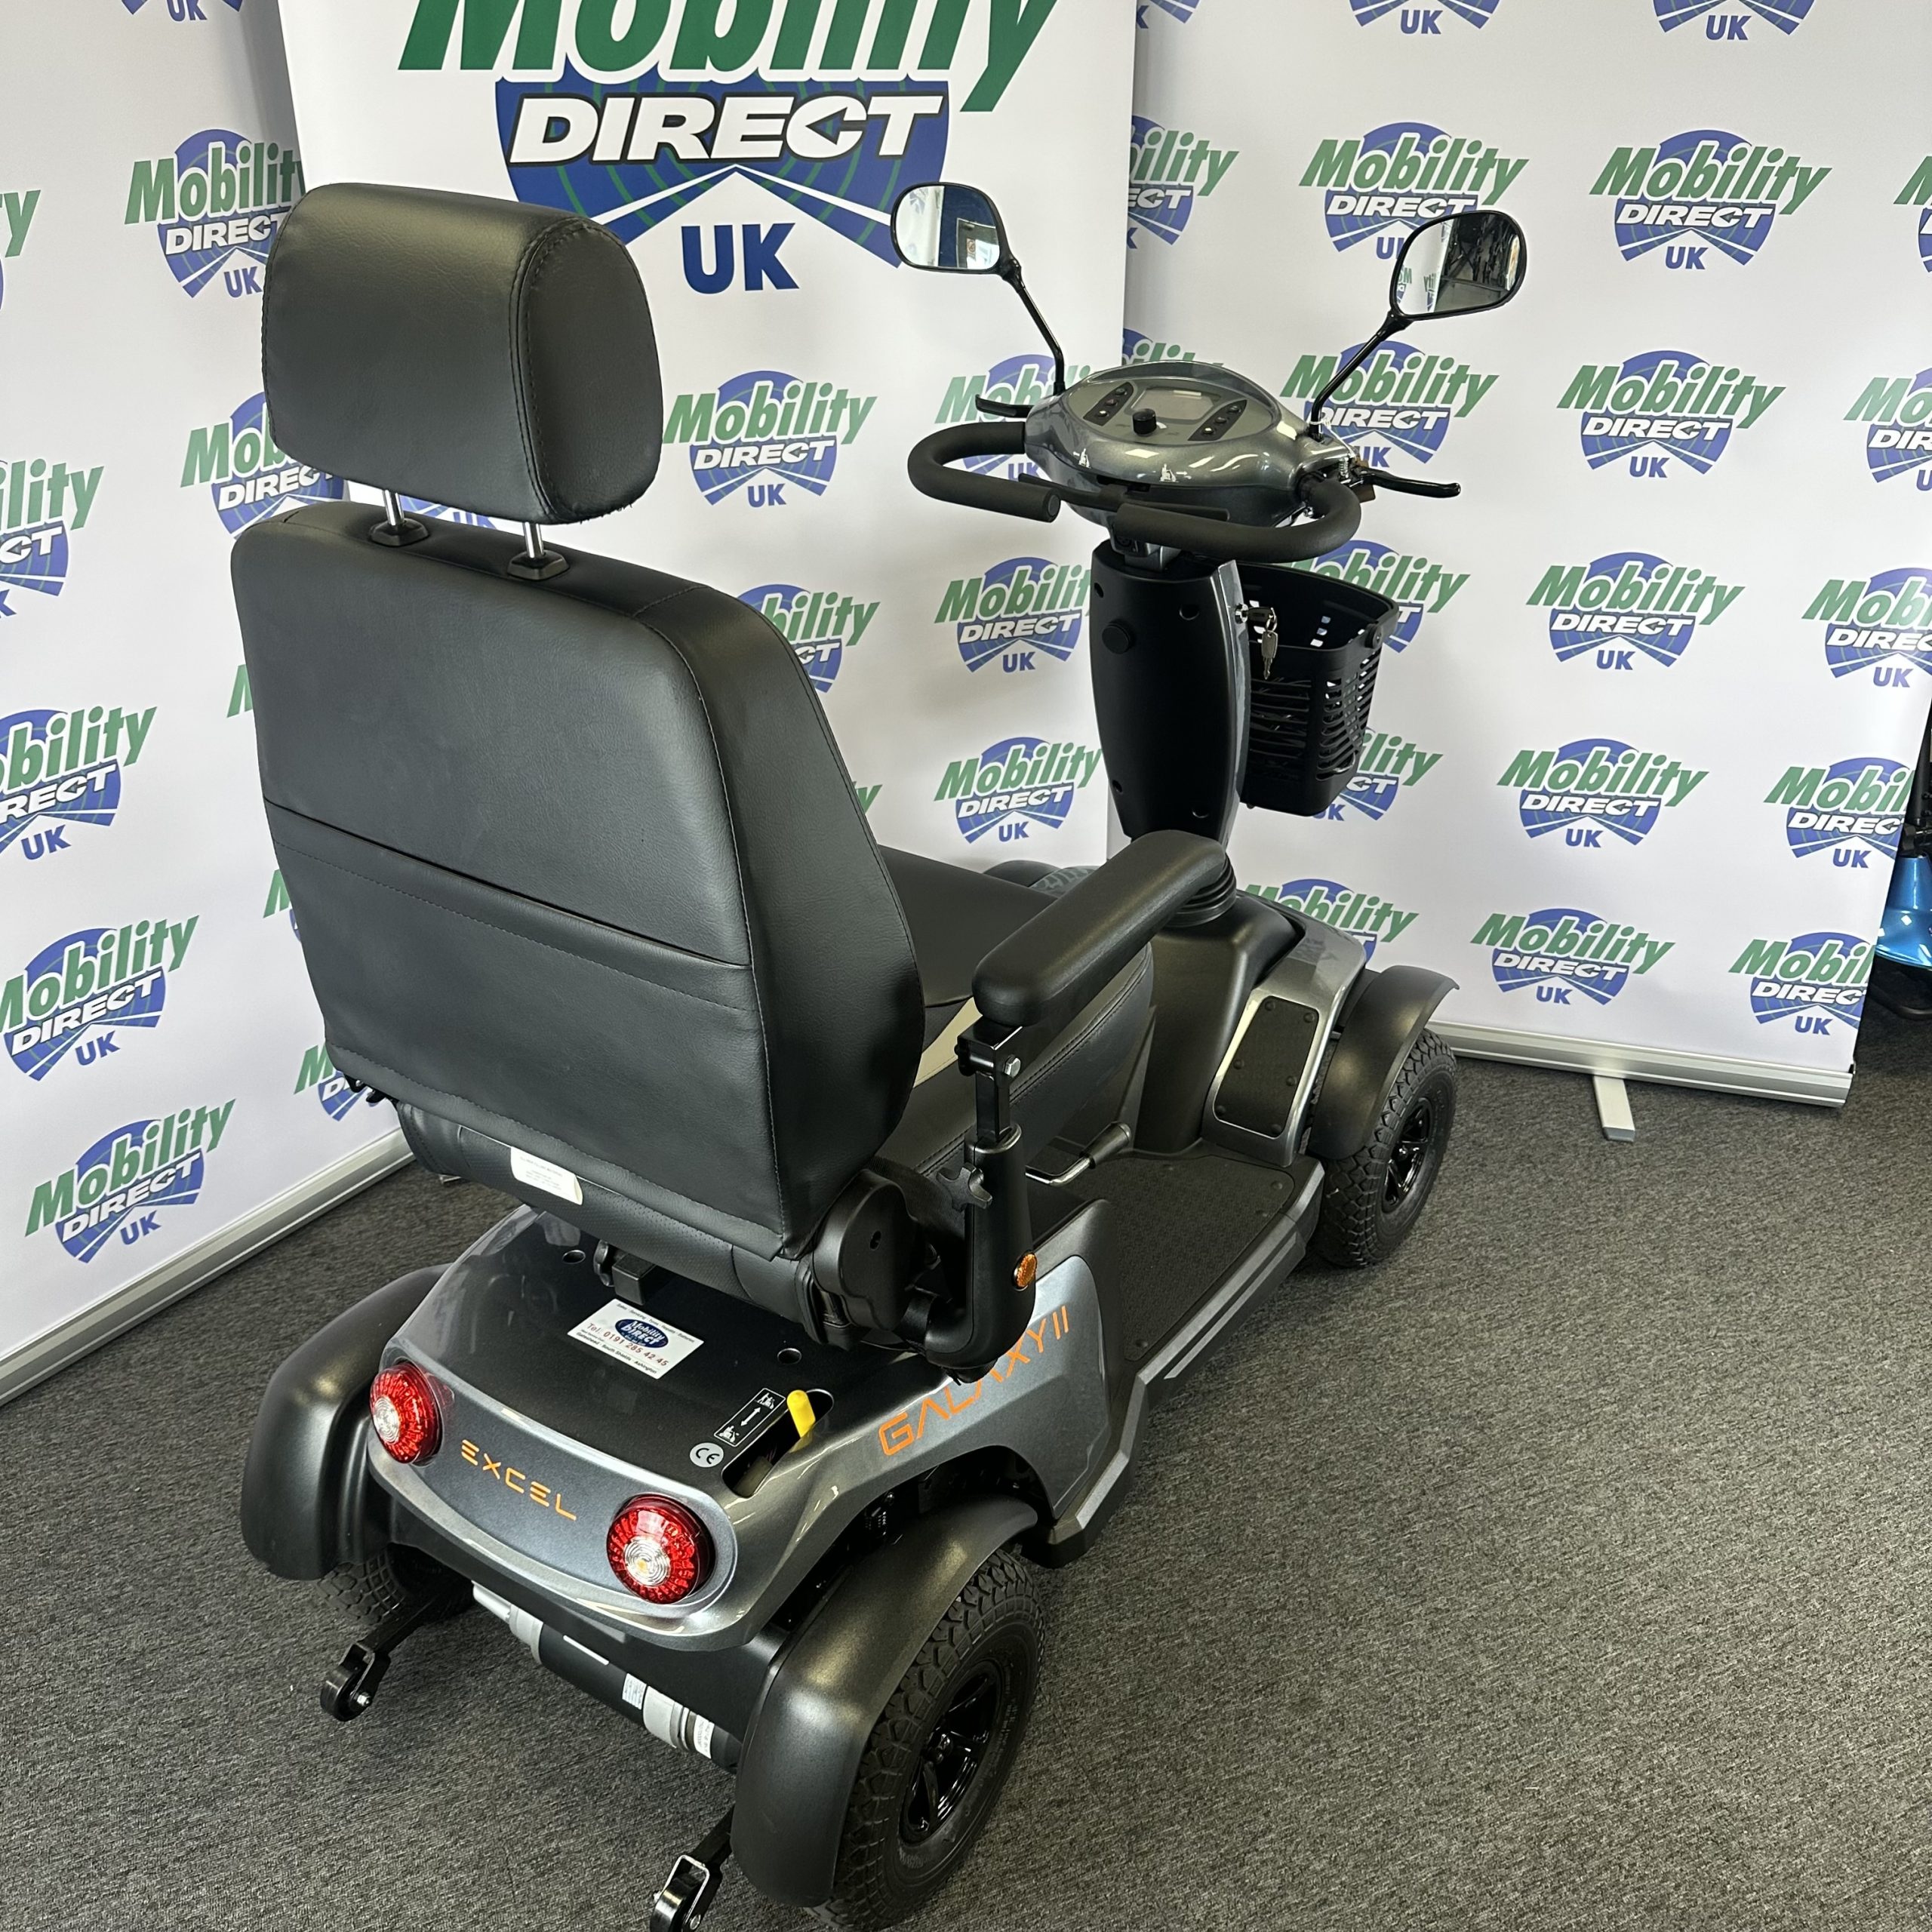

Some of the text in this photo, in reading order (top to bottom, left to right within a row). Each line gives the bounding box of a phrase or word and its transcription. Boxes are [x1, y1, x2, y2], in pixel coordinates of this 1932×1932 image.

[167, 0, 207, 21] UK
[1401, 10, 1443, 35] UK
[1706, 15, 1752, 40] UK
[508, 96, 945, 162] DIRECT
[1131, 130, 1239, 196] ility
[1299, 137, 1530, 205] Mobility
[1589, 145, 1832, 214] Mobility
[1326, 195, 1477, 217] DIRECT
[1617, 203, 1774, 228] DIRECT
[681, 223, 799, 294] UK
[1666, 247, 1707, 269] UK
[223, 266, 262, 298] UK
[1280, 354, 1500, 417] Mobility
[1556, 364, 1786, 429] Mobility
[663, 382, 878, 445] Mobility
[1583, 417, 1730, 441] DIRECT
[1868, 429, 1932, 450] DIR
[694, 441, 834, 470] DIRECT
[1629, 457, 1668, 478] UK
[218, 466, 333, 510] DIREC
[1917, 469, 1932, 491] U
[747, 484, 786, 507] UK
[1526, 565, 1746, 625] Mobility
[761, 592, 881, 647] bility
[959, 614, 1079, 643] DIRECT
[1551, 614, 1693, 635] DIRECT
[1826, 629, 1932, 651] DIREC
[1002, 652, 1035, 672] UK
[1596, 651, 1633, 669] UK
[1873, 667, 1914, 688] UK
[0, 706, 157, 790] bility
[934, 743, 1102, 801] Mobility
[1497, 750, 1709, 807] Mobility
[0, 764, 116, 823] RECT
[958, 786, 1072, 818] DIRECT
[1764, 766, 1915, 812] Mobil
[1521, 795, 1658, 816] DIRECT
[998, 822, 1029, 841] UK
[1565, 828, 1601, 848] UK
[1788, 812, 1904, 835] DIREC
[21, 825, 71, 860] UK
[1833, 849, 1871, 868] UK
[1471, 913, 1675, 974] Mobility
[1494, 954, 1627, 980] DIRECT
[1728, 940, 1875, 984] Mobil
[1536, 986, 1571, 1004] UK
[1752, 981, 1866, 1004] DIREC
[11, 971, 161, 1055] DIRECT
[1795, 1017, 1830, 1035] UK
[75, 1031, 120, 1065] UK
[25, 1099, 235, 1237] Mobility
[62, 1155, 199, 1241] DIRECT
[120, 1211, 162, 1244] UK
[603, 1331, 625, 1344] 0191
[626, 1343, 643, 1353] 285
[621, 1324, 660, 1345] DIRECT
[631, 1321, 665, 1340] Mobility
[461, 1438, 576, 1521] EXCEL
